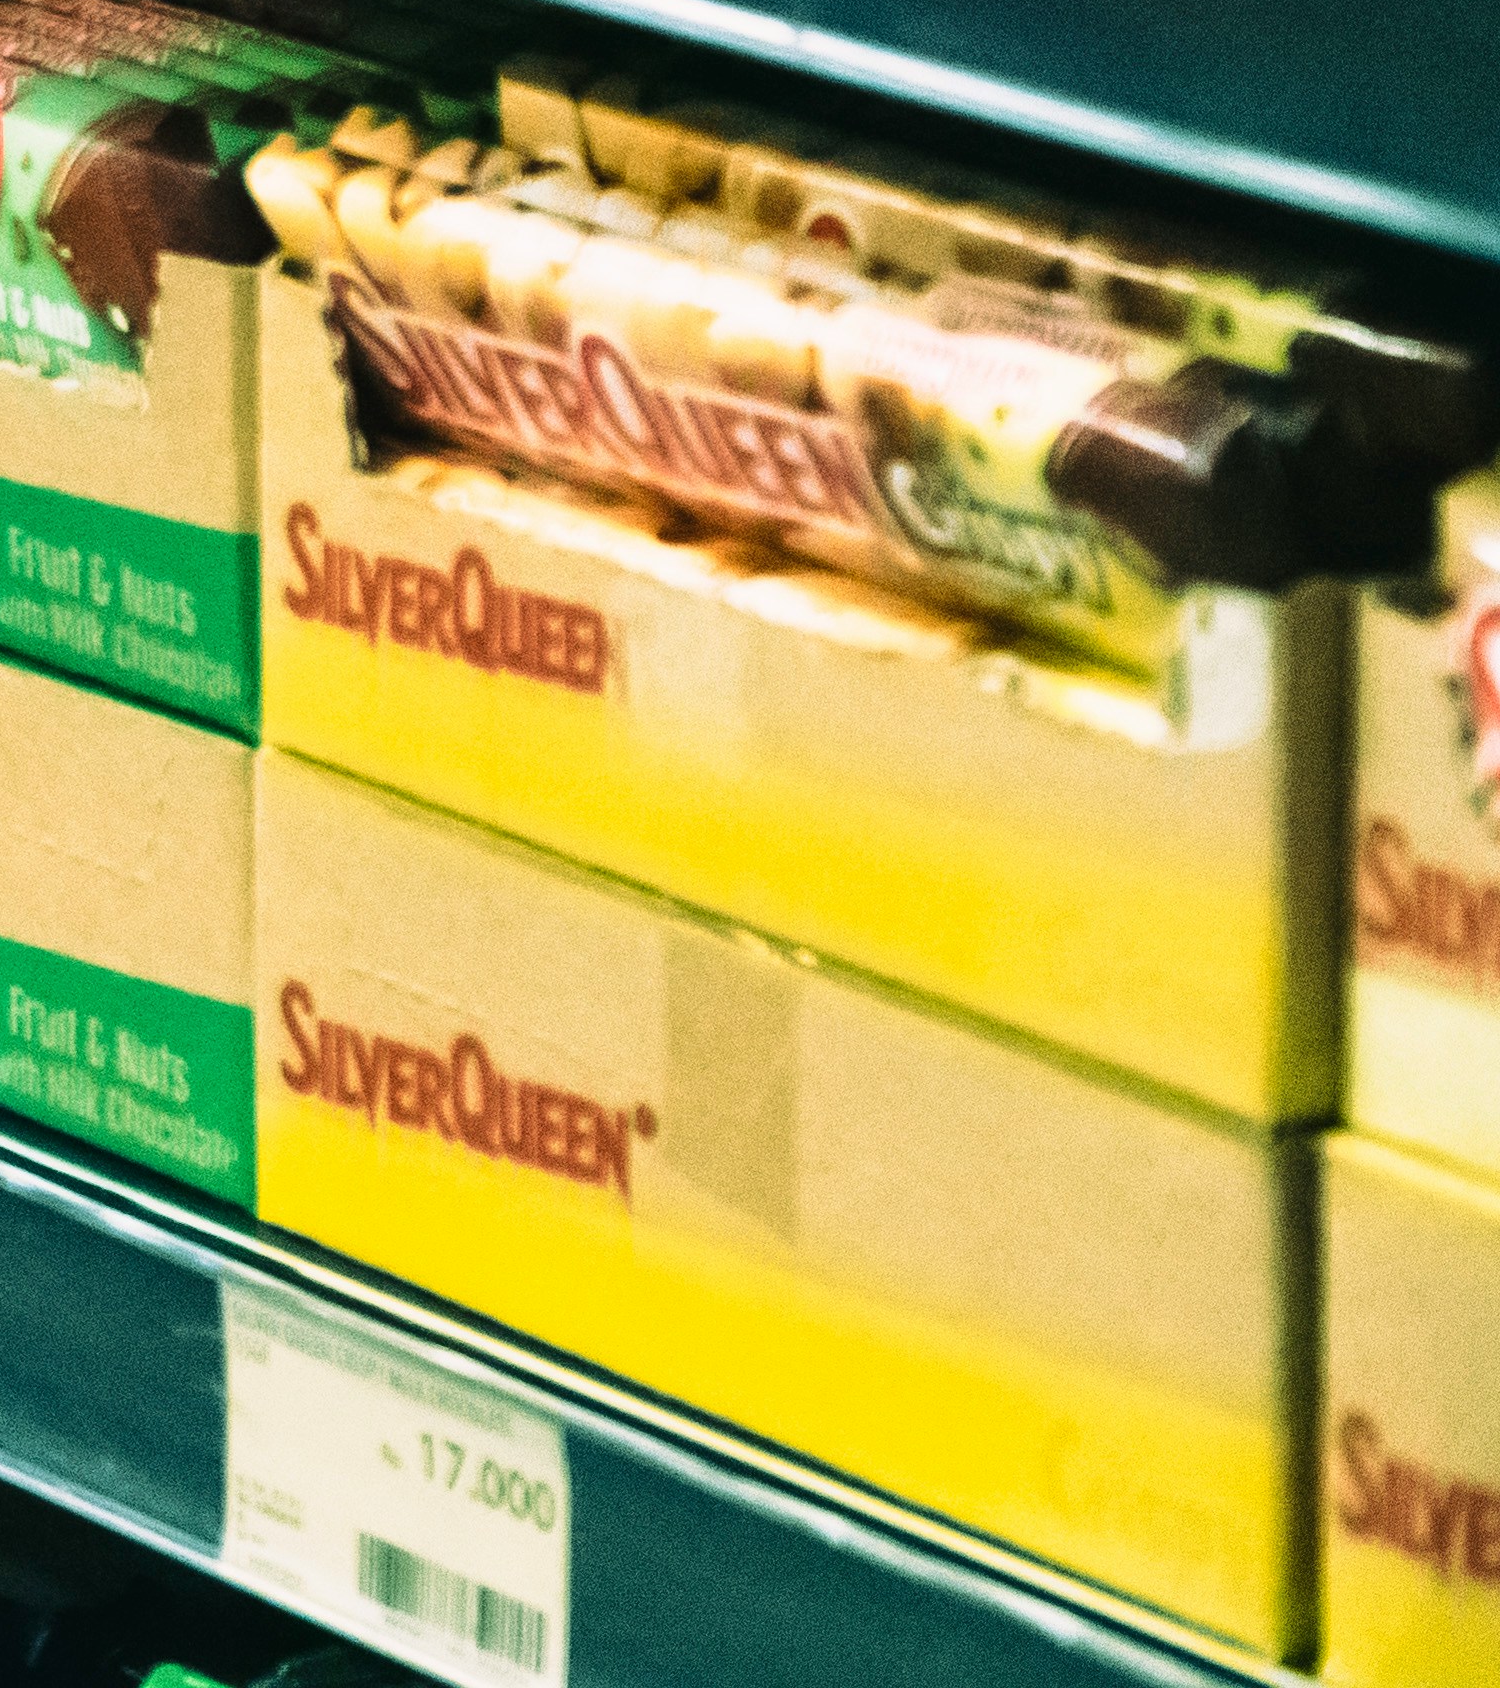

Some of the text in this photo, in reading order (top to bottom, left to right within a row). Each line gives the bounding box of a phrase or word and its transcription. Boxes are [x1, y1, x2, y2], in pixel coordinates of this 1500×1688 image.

[7, 524, 81, 597] Fruit
[119, 564, 198, 638] Nuts
[8, 983, 78, 1059] Fruit
[114, 1026, 191, 1104] Nuts
[278, 979, 632, 1204] SILVERQUEEN
[418, 1430, 557, 1535] 17.000
